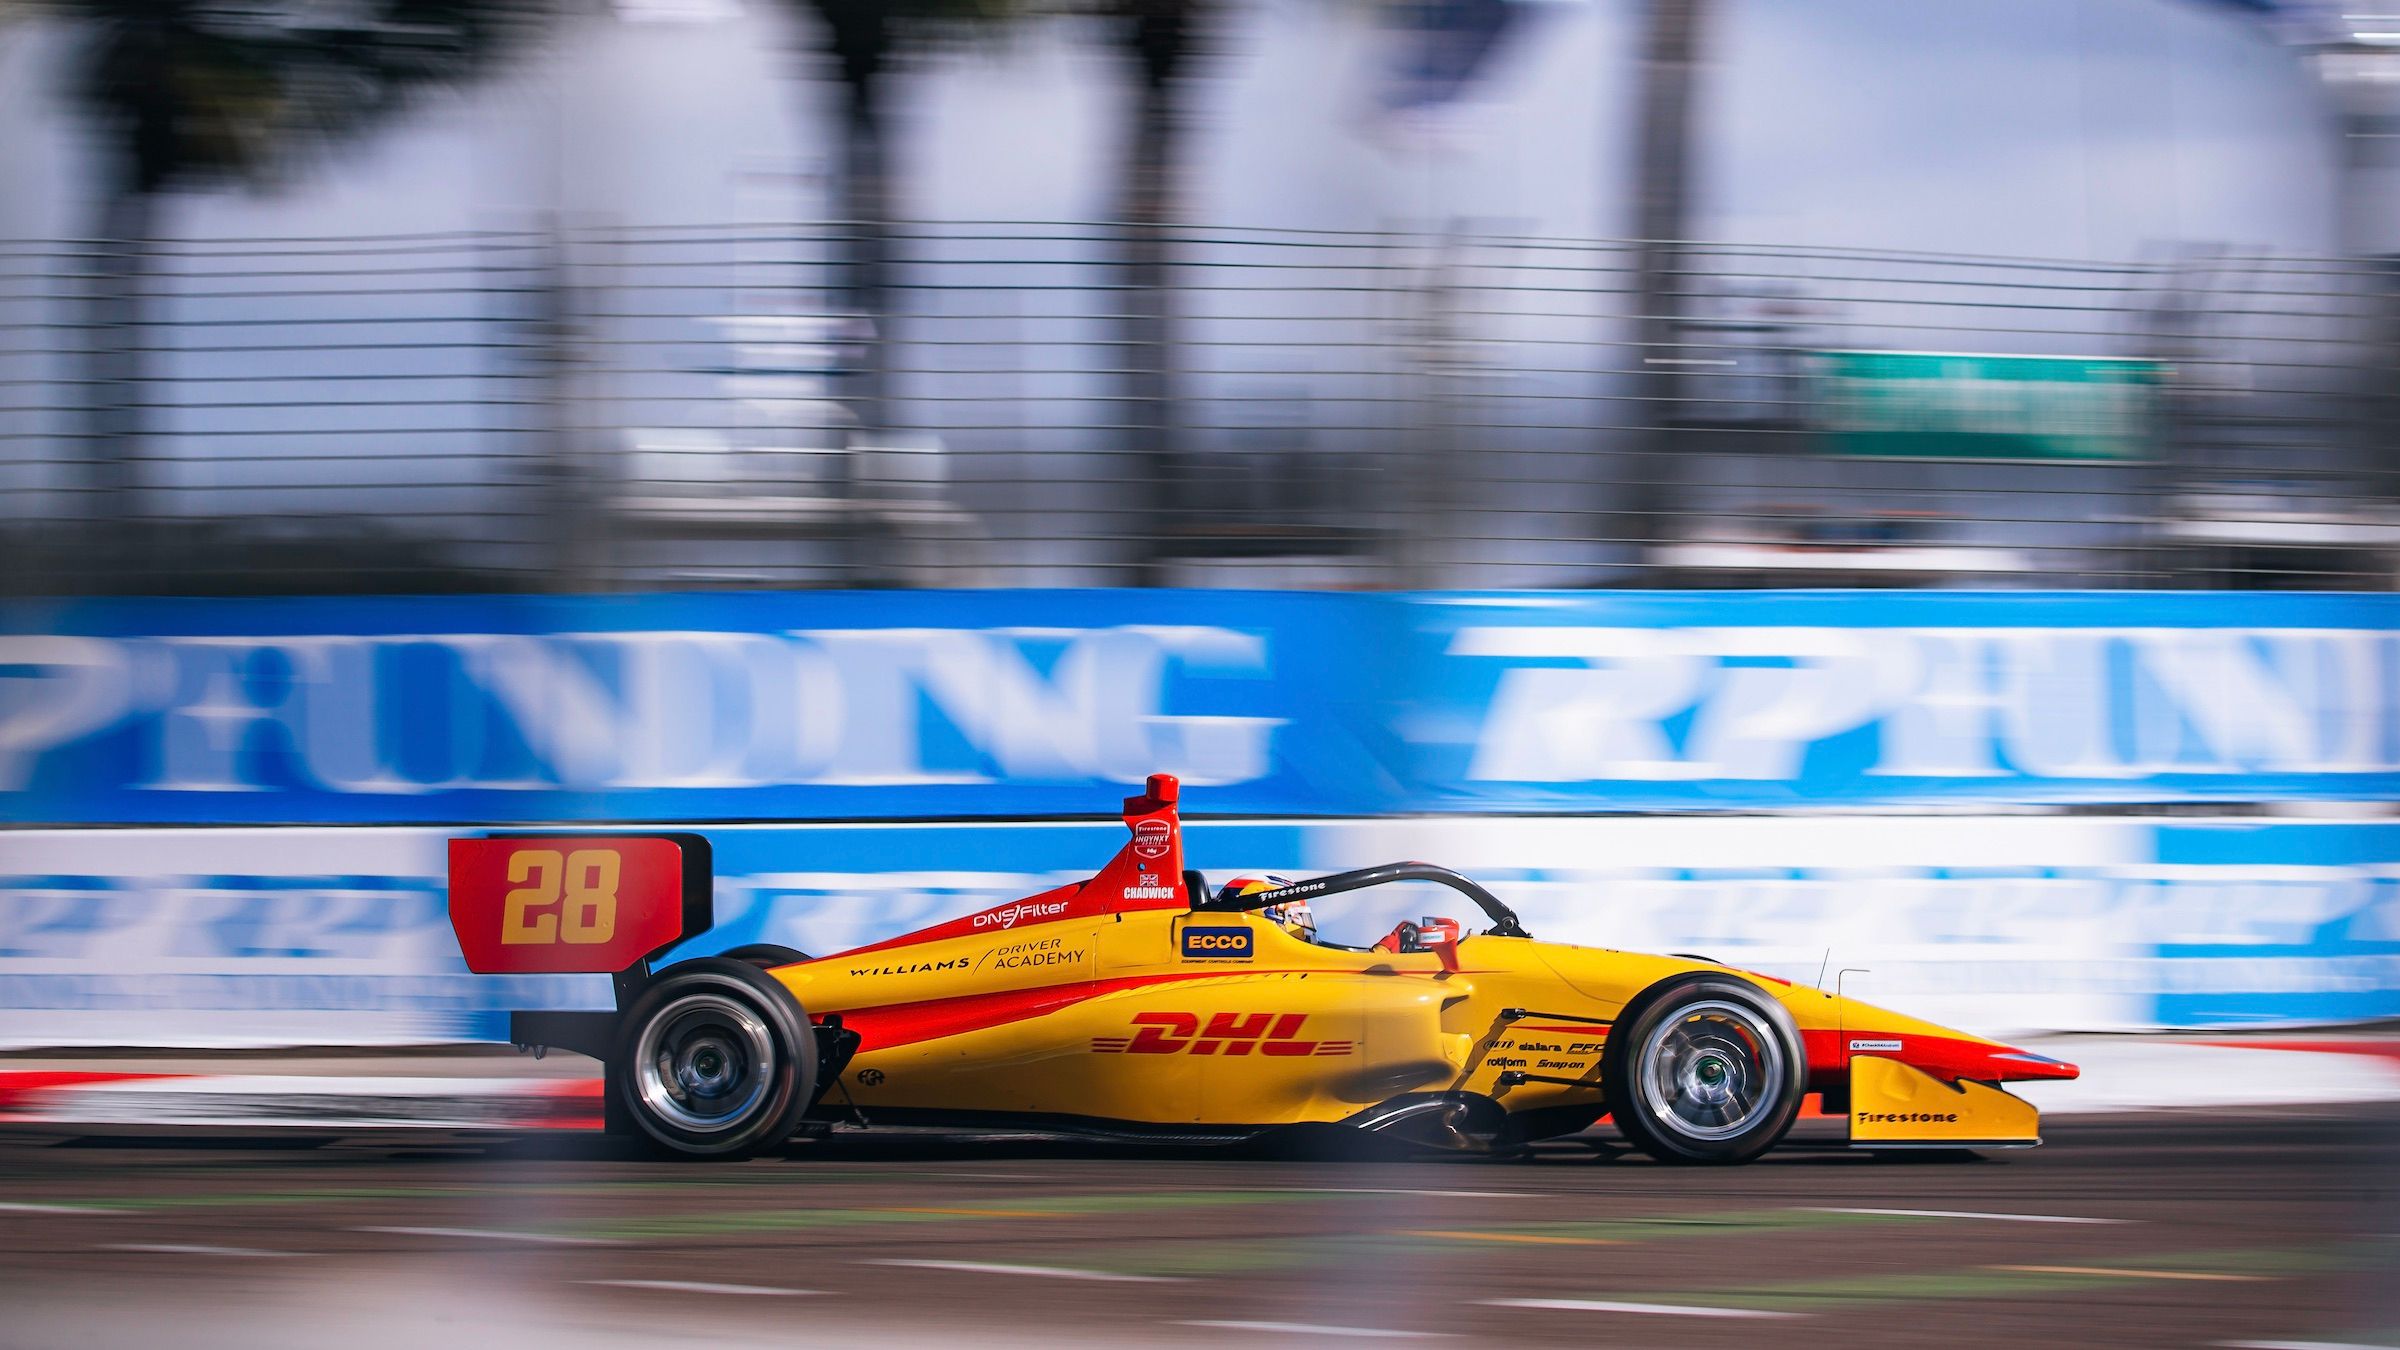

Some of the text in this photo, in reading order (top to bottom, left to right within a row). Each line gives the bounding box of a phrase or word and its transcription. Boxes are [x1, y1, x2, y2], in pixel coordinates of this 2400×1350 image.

[501, 849, 621, 945] 28
[1124, 887, 1174, 900] CHADWICK
[1258, 882, 1326, 902] Firestone
[998, 938, 1061, 957] DRIVER
[1188, 935, 1248, 949] ECCO
[850, 957, 970, 977] WILLIAMS
[994, 949, 1085, 970] ACADEMY
[1124, 1012, 1309, 1057] DHL
[1487, 1057, 1527, 1070] rotiform
[1857, 1112, 1959, 1124] Firestone
